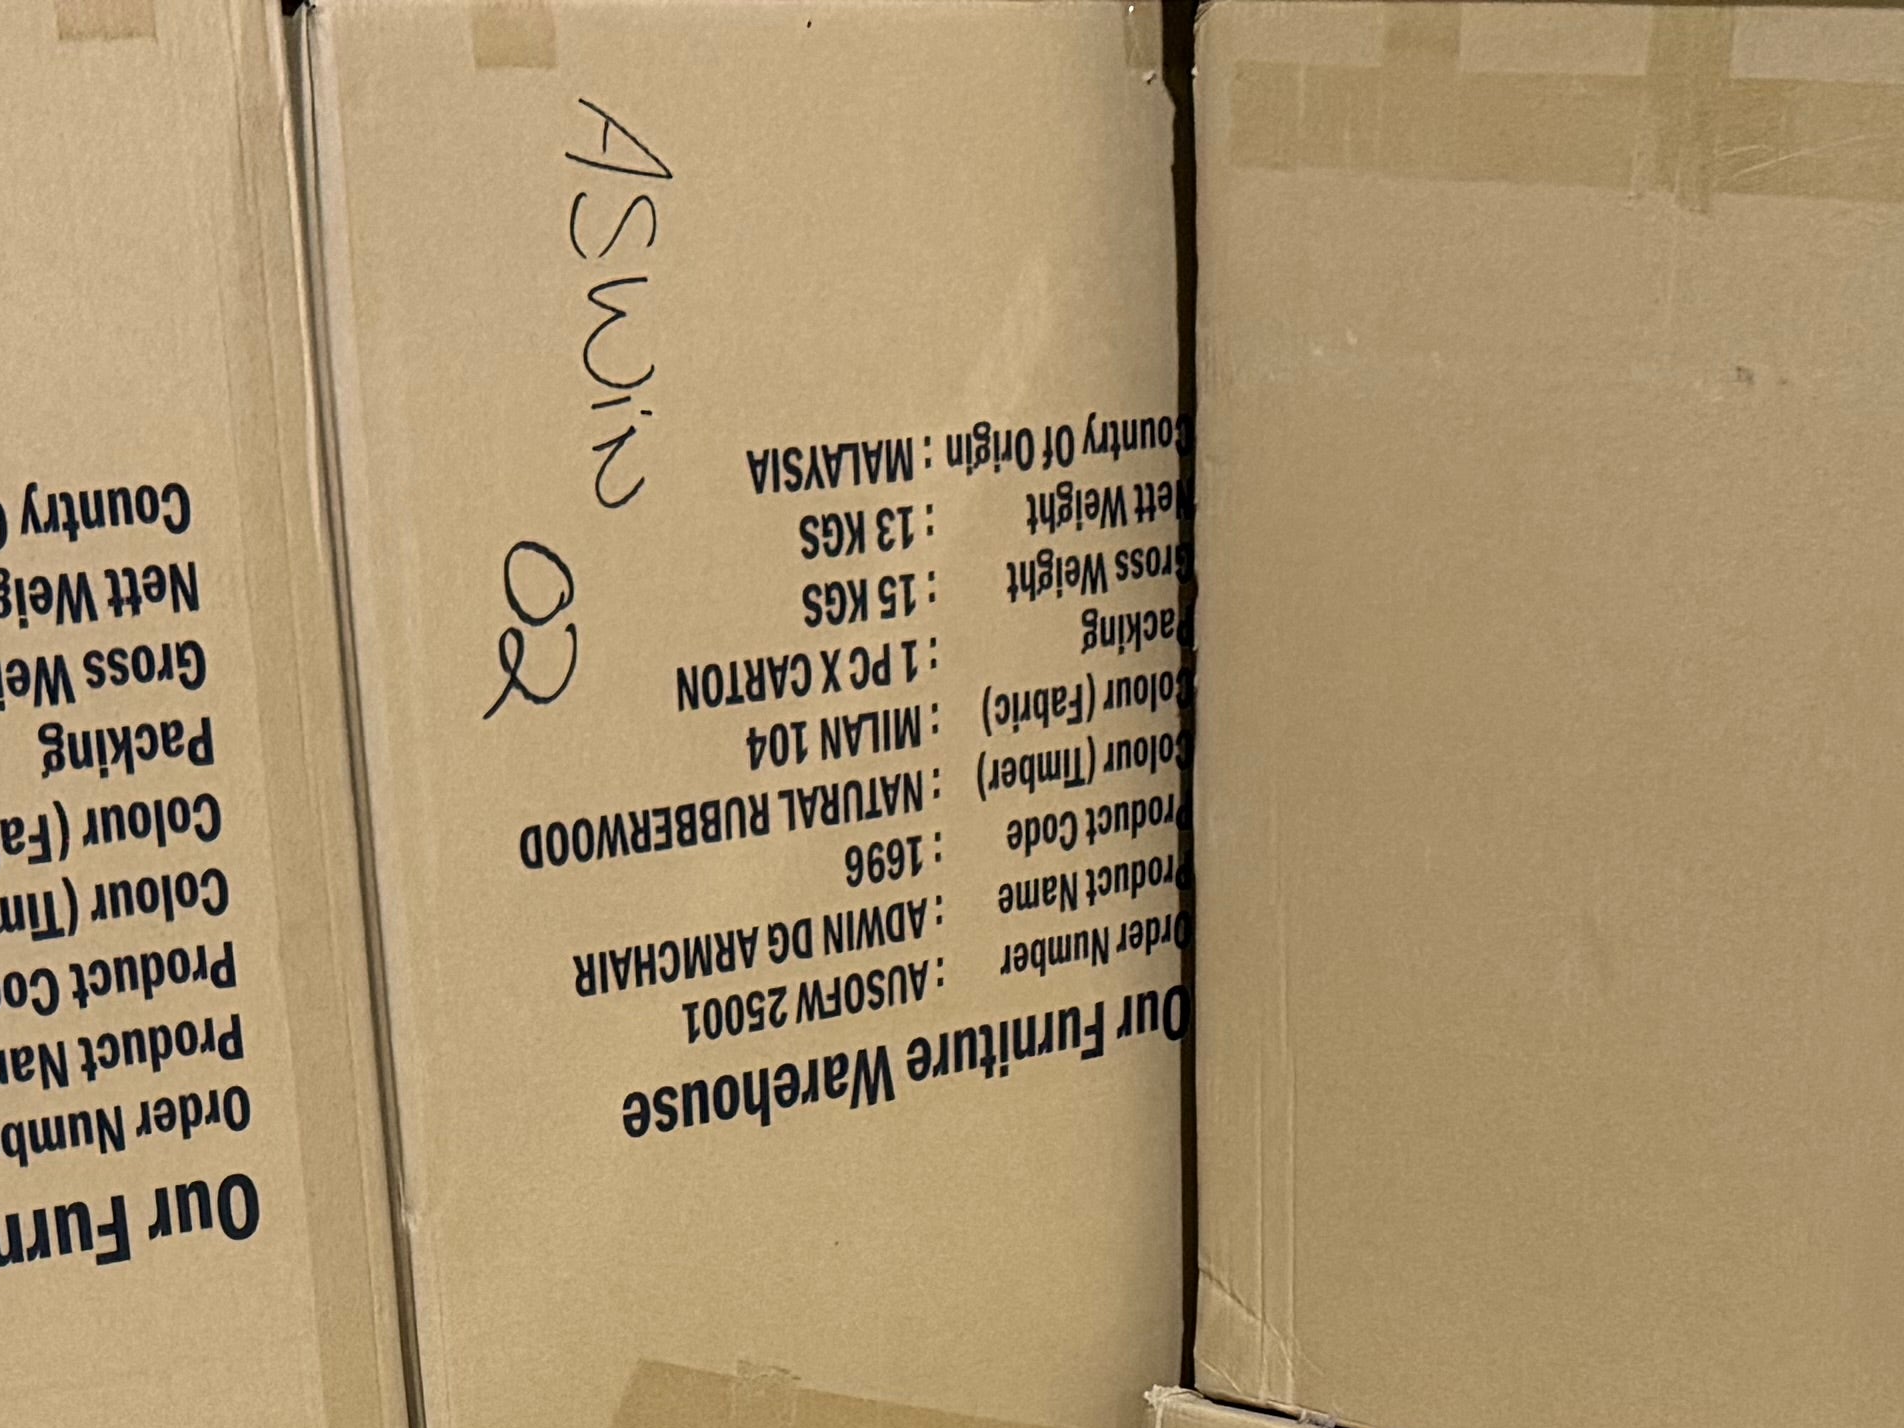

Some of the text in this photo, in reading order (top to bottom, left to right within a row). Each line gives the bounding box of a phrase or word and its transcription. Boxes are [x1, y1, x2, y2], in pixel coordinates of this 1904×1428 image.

[745, 412, 1195, 495] Country Of Origin MALAYSIA
[20, 481, 191, 543] Country
[483, 540, 578, 720] 02
[519, 729, 1194, 870] Colour (Timber) NATURAL RUBBERWOOD
[90, 867, 229, 923] Colour
[68, 940, 237, 1010] Product
[681, 911, 1193, 1044] Order Number AUSOFW 25001
[77, 1013, 244, 1082] Product
[622, 985, 1191, 1138] Our Furniture Warehouse
[147, 1173, 260, 1241] Our
